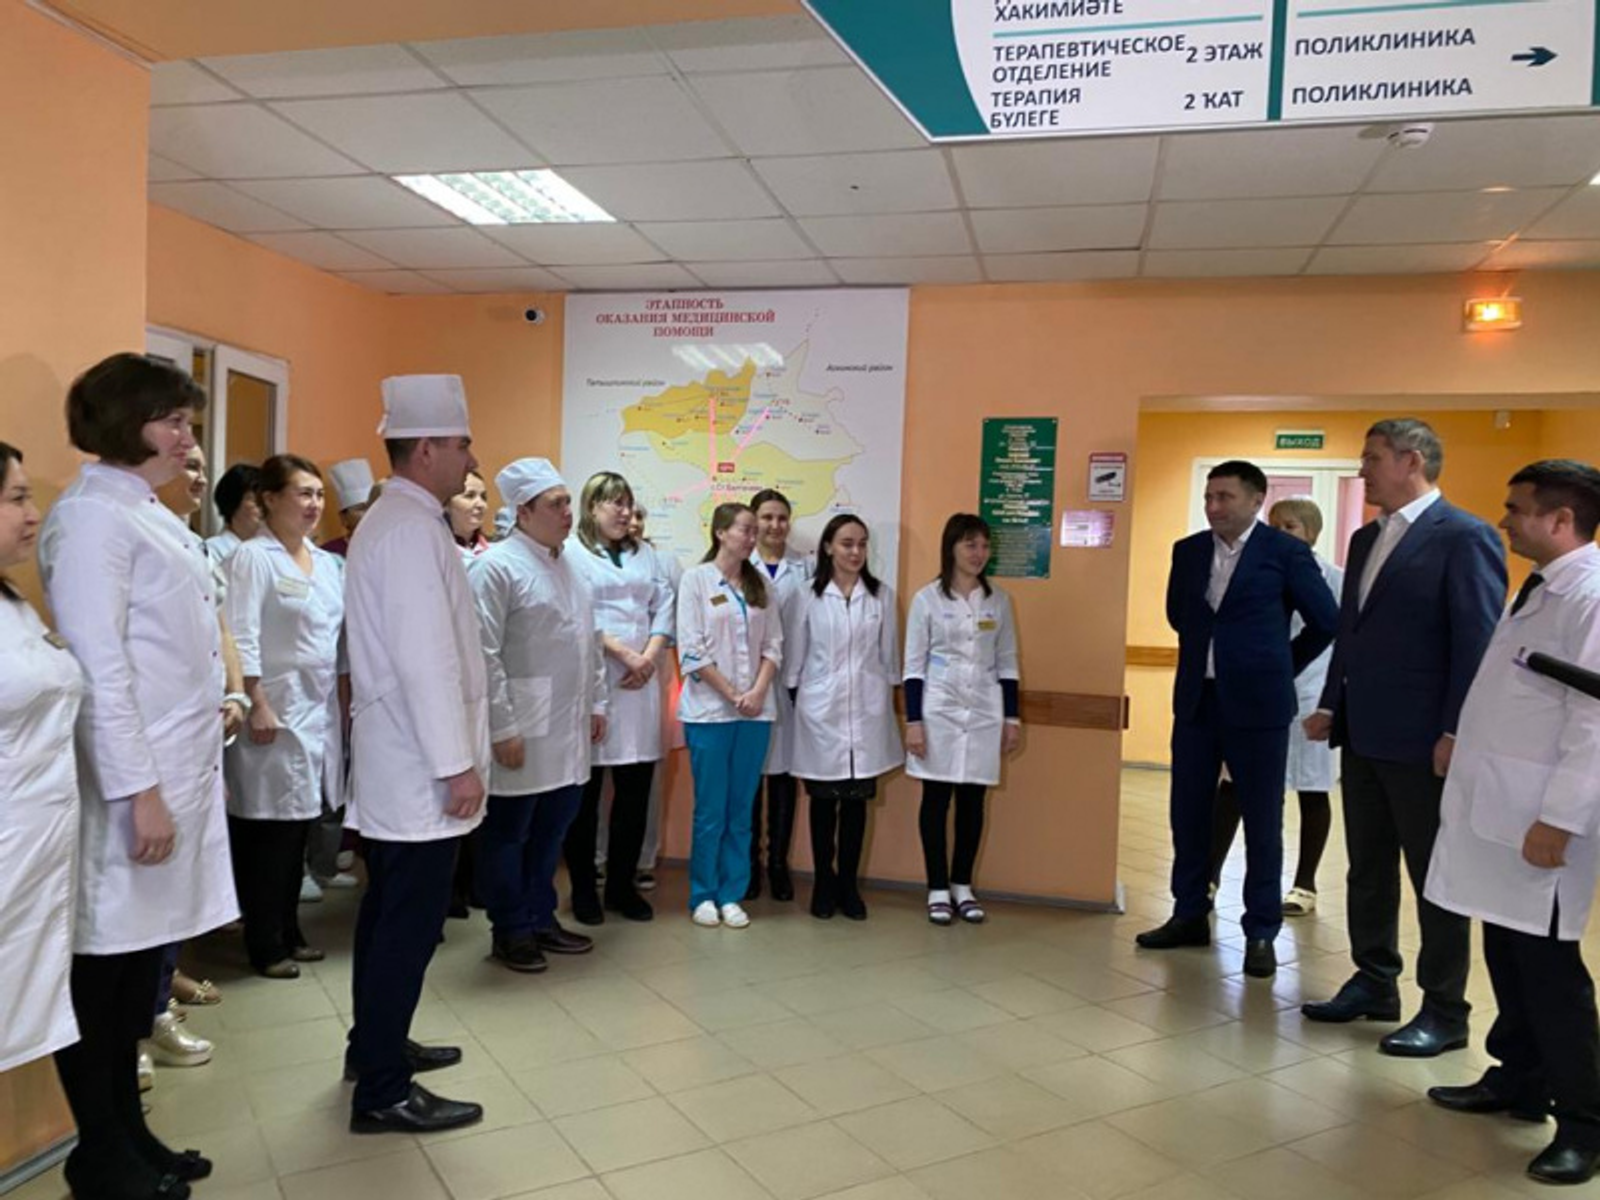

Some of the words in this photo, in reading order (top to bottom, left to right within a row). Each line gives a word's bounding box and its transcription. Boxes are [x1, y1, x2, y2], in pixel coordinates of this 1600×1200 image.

[994, 34, 1186, 62] ТЕРАПЕВТИЧЕСКОЕ
[1294, 28, 1476, 56] ПОЛИКЛИНИКА
[1186, 47, 1198, 63] 2
[1204, 43, 1264, 62] ЭТАЖ
[992, 61, 1112, 85] ОТДЕЛЕНИЕ
[991, 88, 1082, 108] ТЕРАПИЯ
[1292, 78, 1473, 104] ПОЛИКЛИНИКА
[1184, 94, 1196, 110] 2
[645, 298, 724, 310] ЭТАПНОСТЬ
[596, 313, 667, 324] ОКАЗАНИЯ
[672, 309, 776, 323] МЕДИЦИНСКОЙ
[653, 326, 714, 337] ПОМОЩИ
